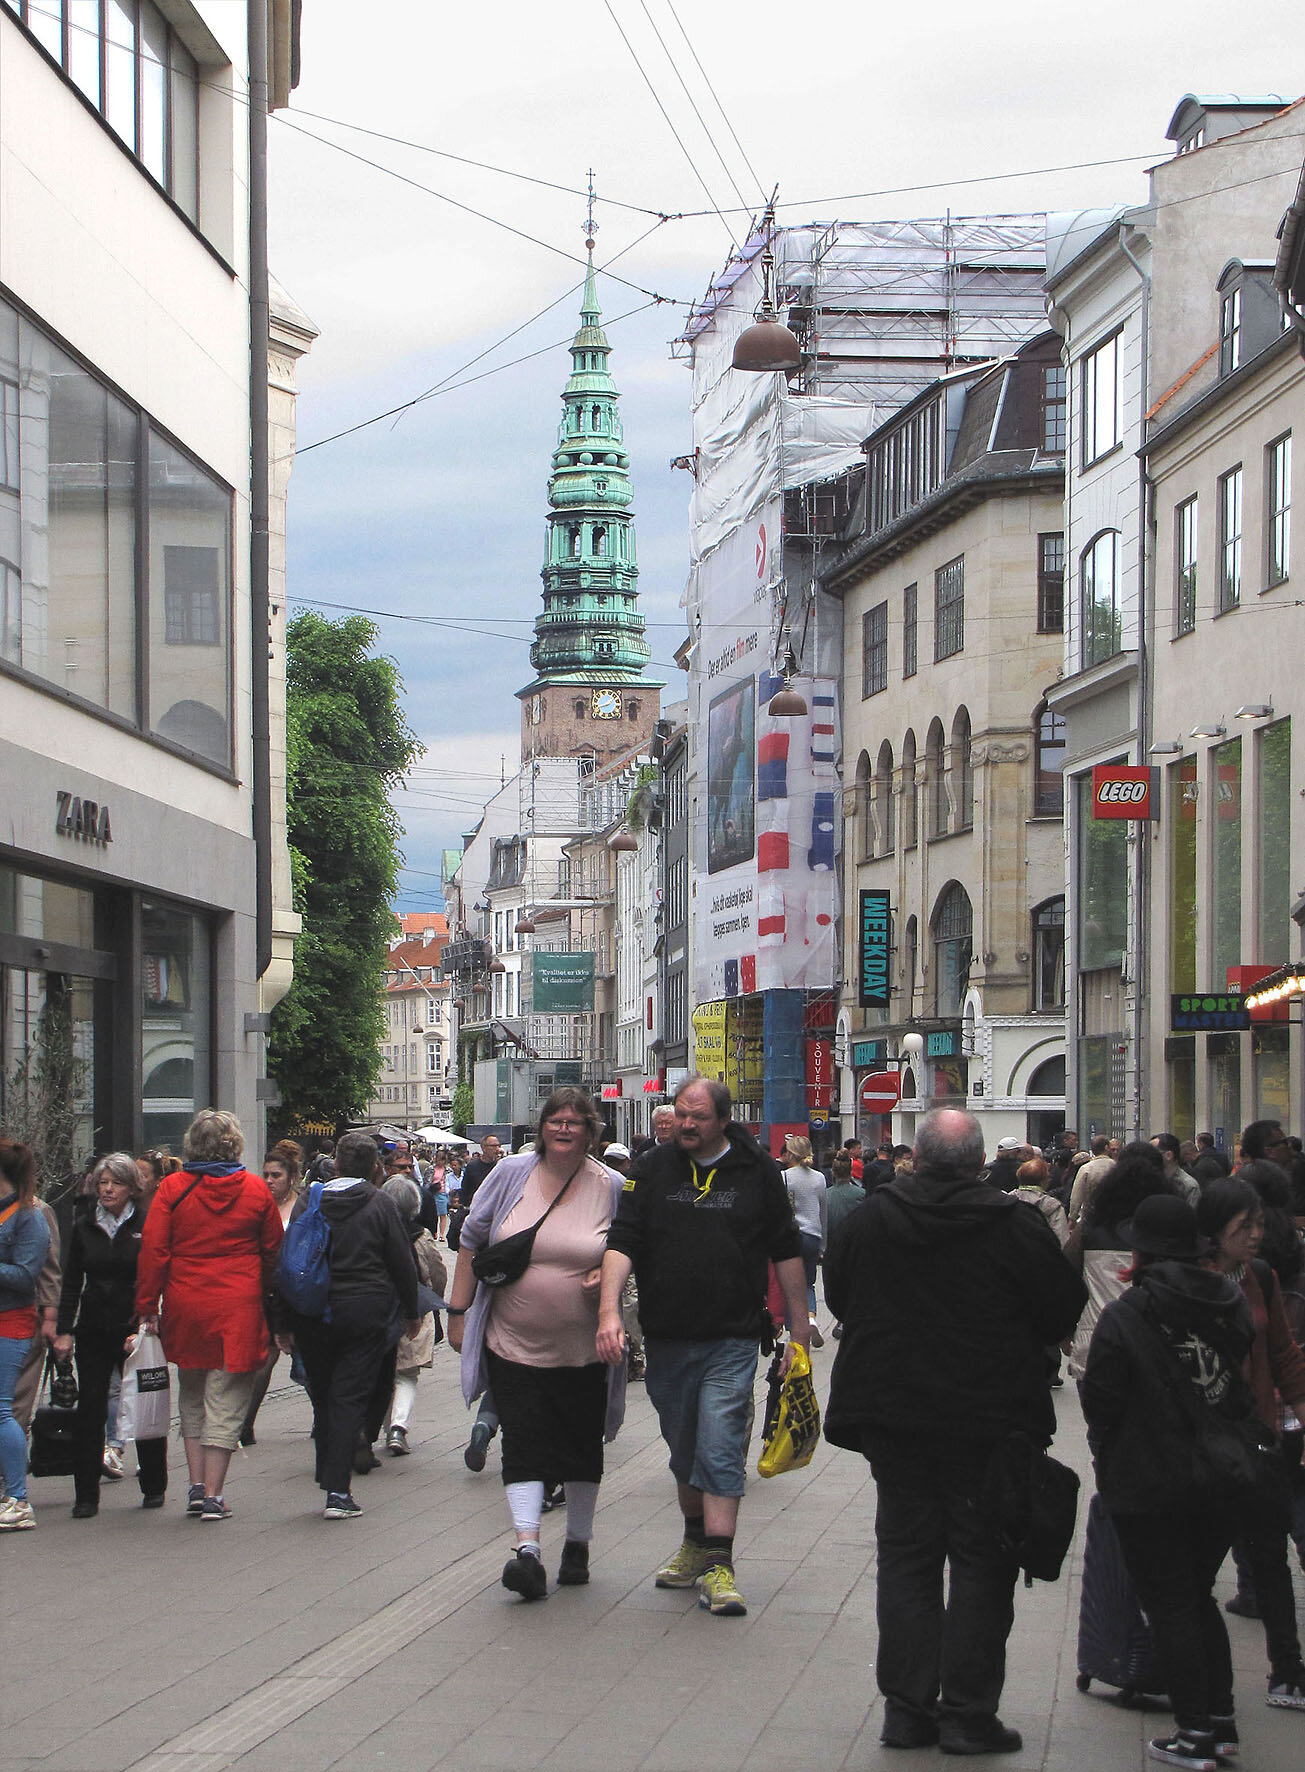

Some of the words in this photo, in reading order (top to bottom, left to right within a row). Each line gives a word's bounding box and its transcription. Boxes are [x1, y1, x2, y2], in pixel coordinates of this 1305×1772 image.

[737, 637, 745, 660] film
[746, 631, 758, 654] mere
[1098, 780, 1147, 803] LEGO
[56, 791, 113, 843] ZARA
[863, 897, 888, 1000] WEEKDAY
[1180, 998, 1240, 1013] SPORT
[813, 1041, 823, 1107] SOUVENIR
